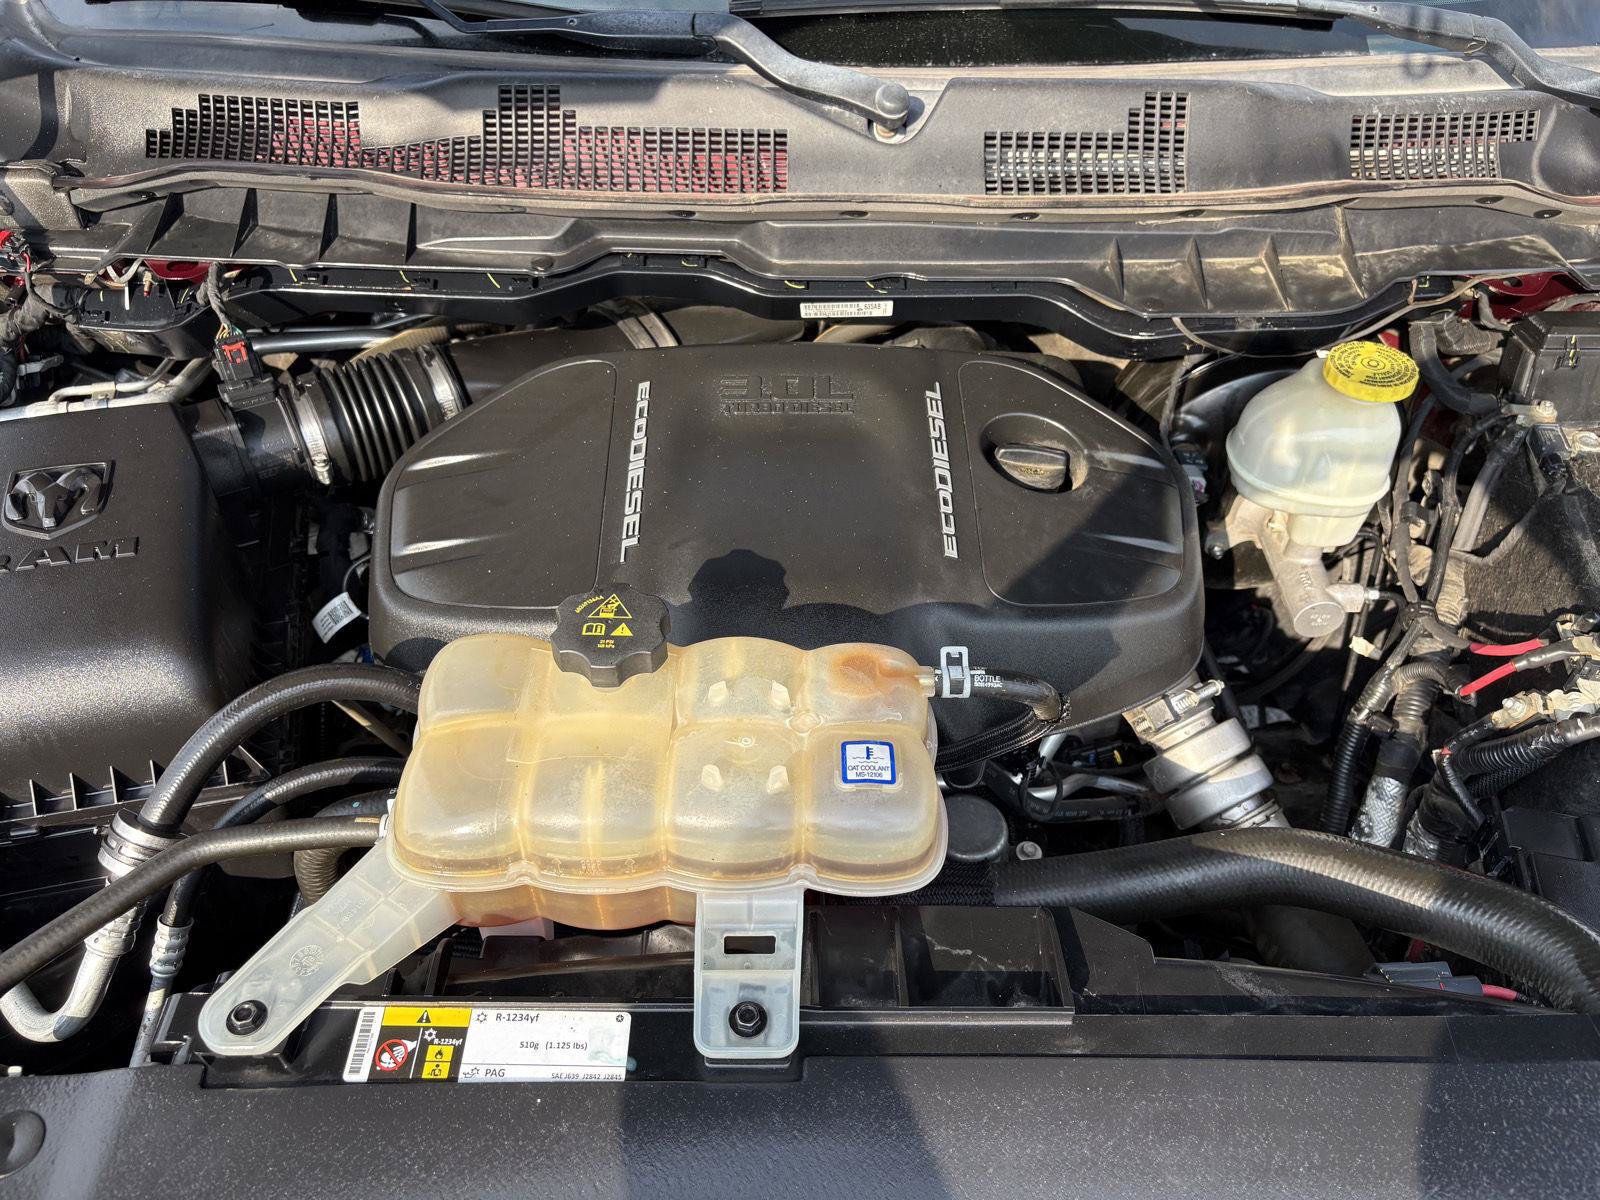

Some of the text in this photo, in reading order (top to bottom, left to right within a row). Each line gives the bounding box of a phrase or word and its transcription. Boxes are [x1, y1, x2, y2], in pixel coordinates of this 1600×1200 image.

[619, 381, 651, 563] ECODIESEL
[925, 381, 959, 559] ECODIESEL
[974, 674, 1001, 683] BOTTLE
[495, 1012, 540, 1024] R-1234yf
[433, 1038, 463, 1047] R-1234yf
[519, 1041, 588, 1050] 510g (1.125 lbs)
[484, 1068, 506, 1078] PAG
